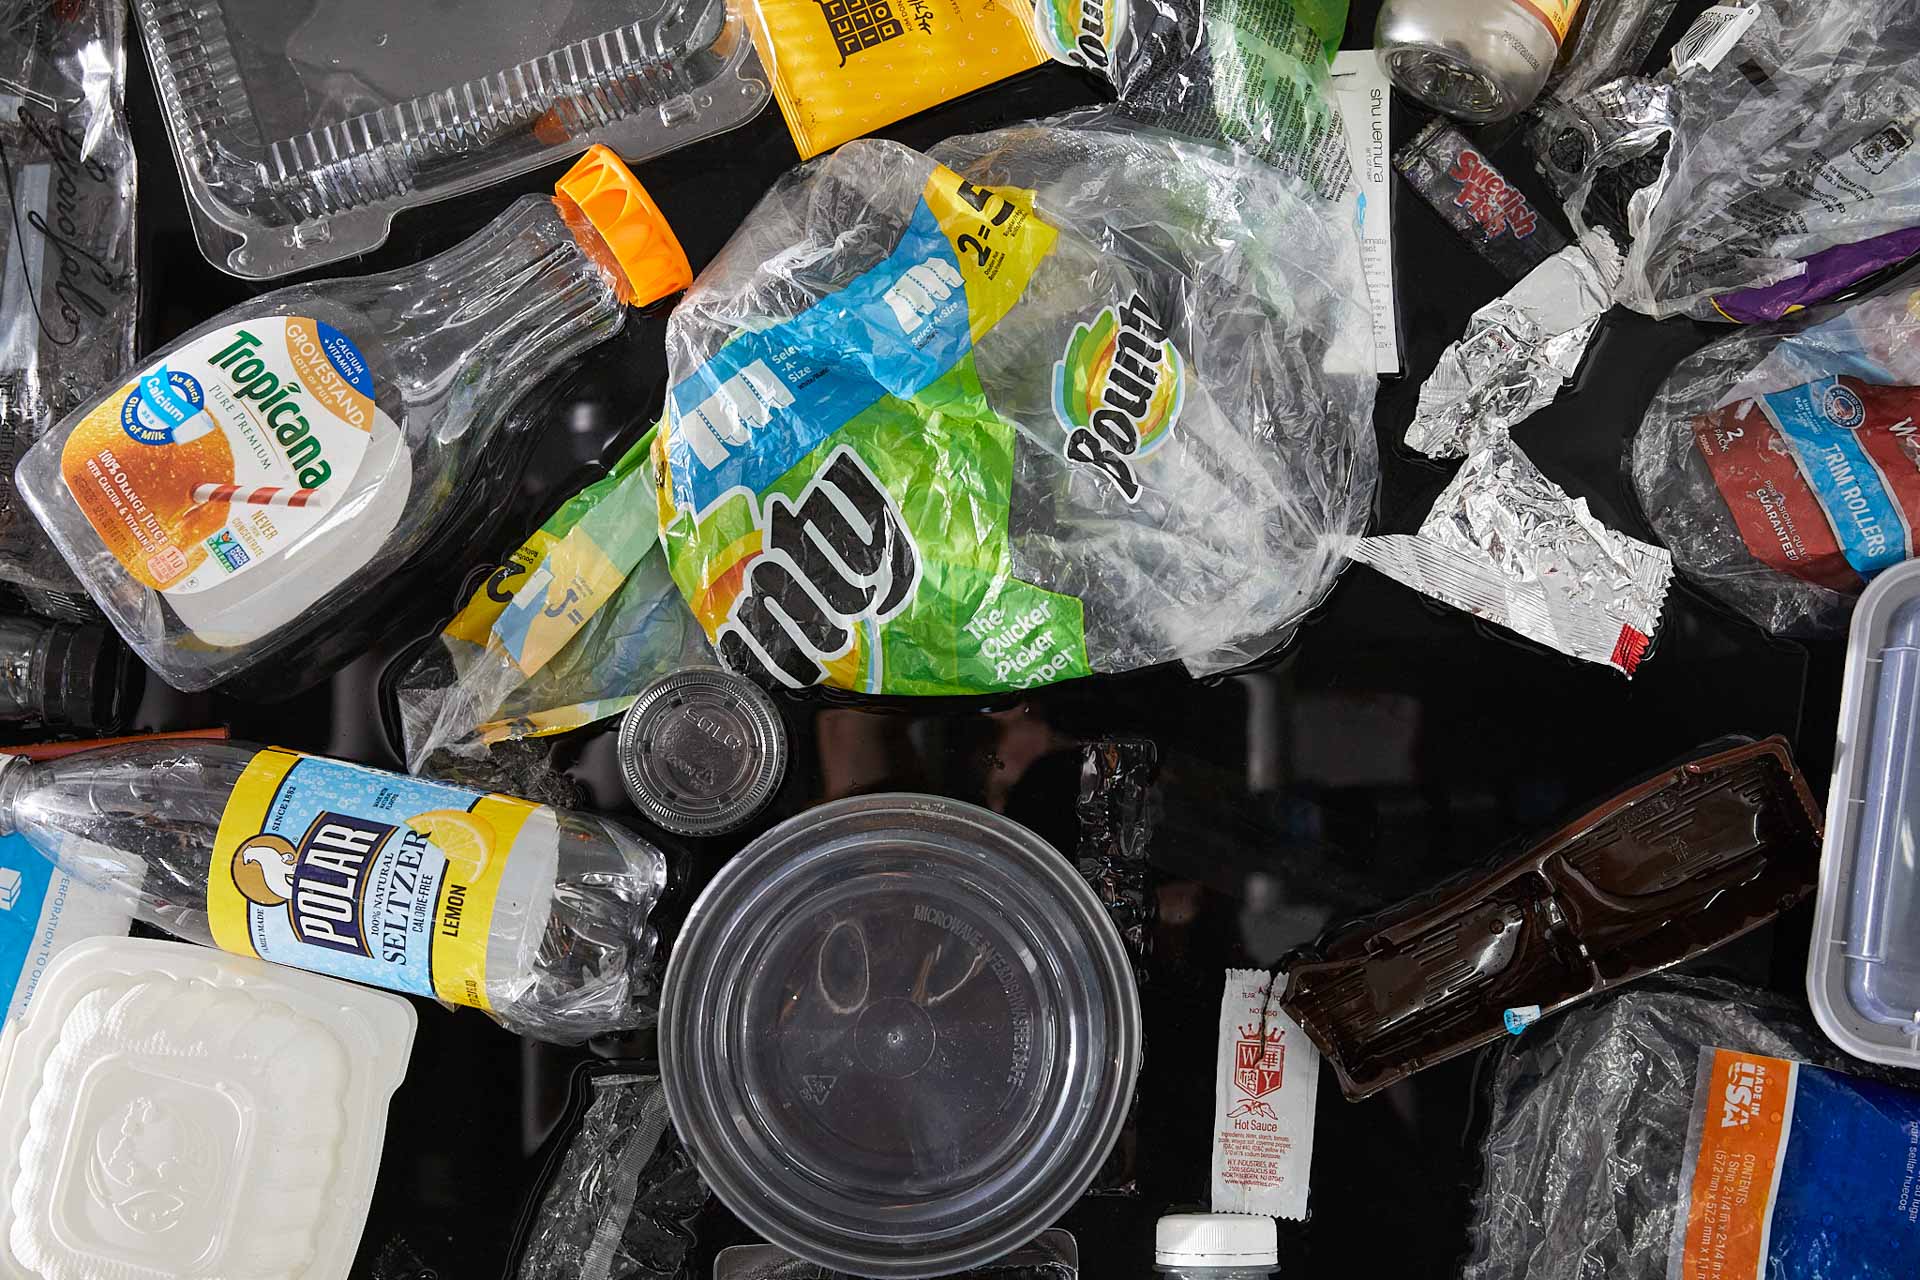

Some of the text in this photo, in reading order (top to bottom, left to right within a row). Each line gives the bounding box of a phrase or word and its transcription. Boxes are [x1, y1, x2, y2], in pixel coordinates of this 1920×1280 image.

[1370, 88, 1384, 184] shu uemura
[1452, 150, 1537, 239] Swedish
[327, 343, 360, 385] VITAMIN D
[335, 338, 364, 375] CALCIUM
[787, 364, 812, 384] Size
[170, 373, 200, 404] As Much
[292, 351, 311, 377] LOTS
[315, 383, 334, 405] PULP
[147, 377, 185, 421] Calcium
[207, 329, 332, 489] Tropicana
[125, 397, 166, 441] Glass of Milk
[208, 384, 273, 470] PURE PREMIUM
[1726, 427, 1744, 444] 2
[1713, 428, 1729, 452] PACK
[98, 449, 121, 475] 100%
[86, 458, 102, 480] WITH
[99, 475, 123, 509] CALCIUM
[124, 513, 152, 546] VITAMIN
[1821, 443, 1857, 487] TRIM
[1841, 486, 1887, 557] ROLLERS
[251, 510, 279, 540] NEVER
[1755, 487, 1800, 562] GUARANTEED
[235, 546, 249, 562] NON
[1791, 534, 1808, 558] QUAL
[962, 608, 1004, 641] The
[980, 600, 1052, 659] Quicker
[993, 630, 1057, 682] Picker
[271, 785, 296, 832] SINCE 1882
[298, 823, 382, 949] POLAR
[371, 853, 395, 936] 100% NATURAL
[382, 828, 432, 966] SELTZER
[412, 873, 435, 933] CALORIE-FREE
[256, 908, 265, 931] MADE
[442, 884, 468, 938] LEMON
[913, 903, 982, 949] MICROWAVE
[36, 951, 50, 966] TO
[24, 969, 42, 1000] OPEN
[1241, 1047, 1258, 1063] W
[1262, 1072, 1275, 1090] Y
[1722, 1061, 1756, 1128] USA
[1750, 1065, 1766, 1117] MADE IN
[1234, 1119, 1278, 1133] Hot Sauce
[1712, 1150, 1727, 1173] (57.2
[1728, 1160, 1740, 1183] Strip
[1735, 1154, 1756, 1206] CONTENTS:
[1898, 1121, 1919, 1211] para sellar huecos
[1710, 1175, 1720, 1191] mm
[1720, 1186, 1732, 1214] 2-1/4
[1704, 1202, 1717, 1225] 57.2
[1909, 1199, 1920, 1223] lugar
[1702, 1226, 1712, 1245] mm
[1715, 1230, 1727, 1260] 2-1/4
